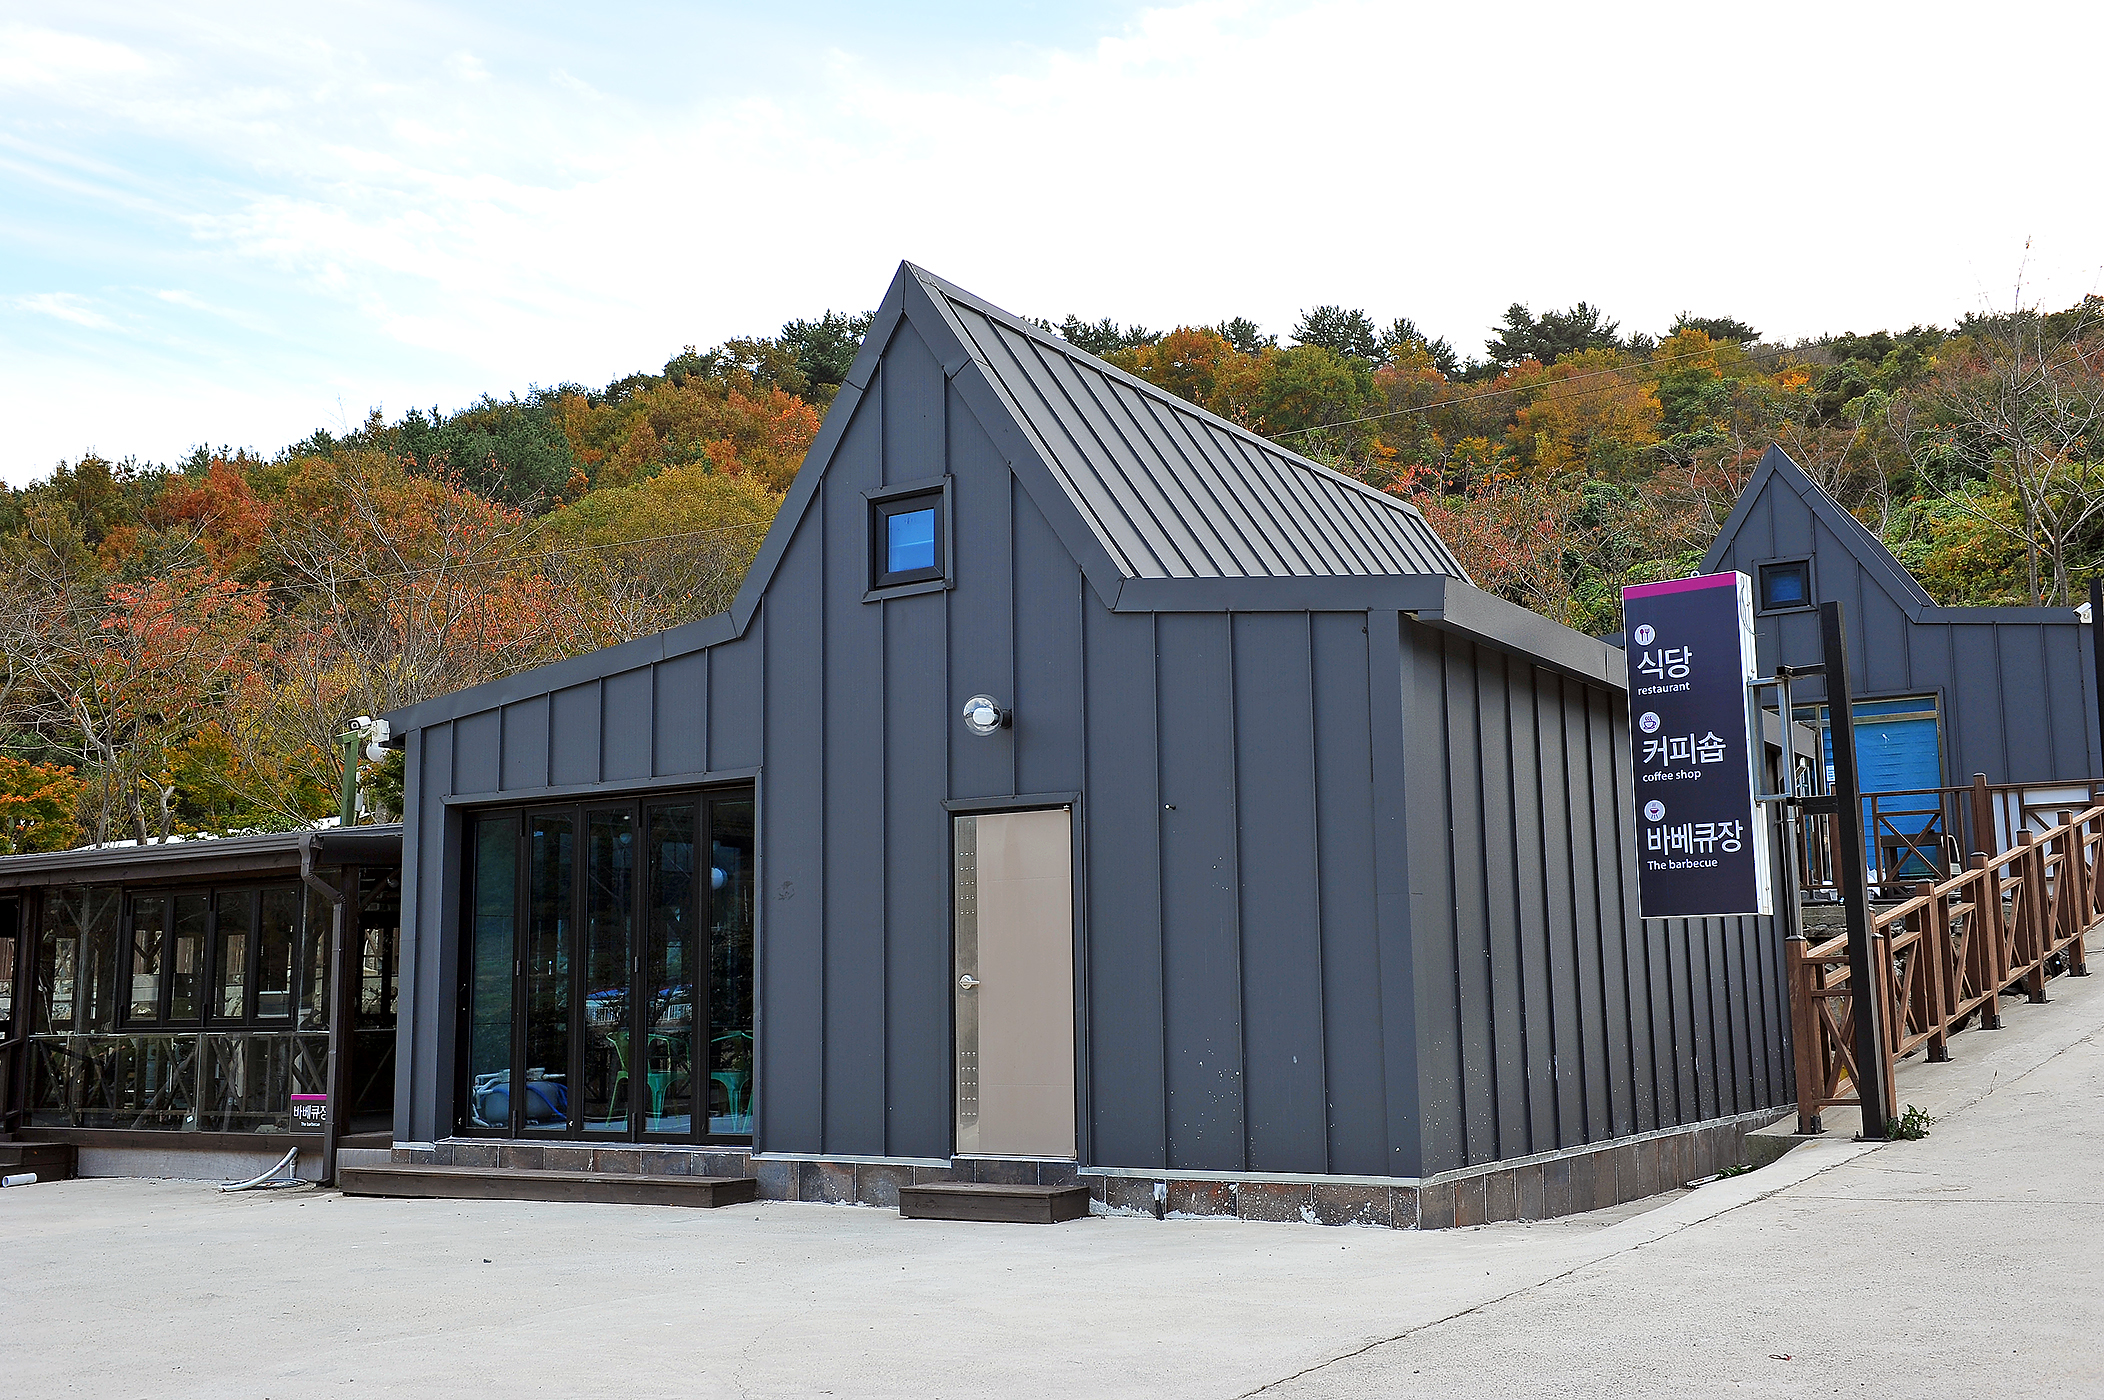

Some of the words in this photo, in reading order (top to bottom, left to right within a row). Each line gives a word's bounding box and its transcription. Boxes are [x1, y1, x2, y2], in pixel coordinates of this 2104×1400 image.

[1637, 645, 1693, 680] 식당
[1637, 682, 1691, 696] restaurant
[1643, 731, 1727, 766] 커피숍
[1642, 771, 1674, 782] coffee
[1675, 769, 1702, 781] shop
[1646, 819, 1744, 856] 바베큐장
[1646, 860, 1667, 871] The
[1668, 858, 1719, 870] barbecue
